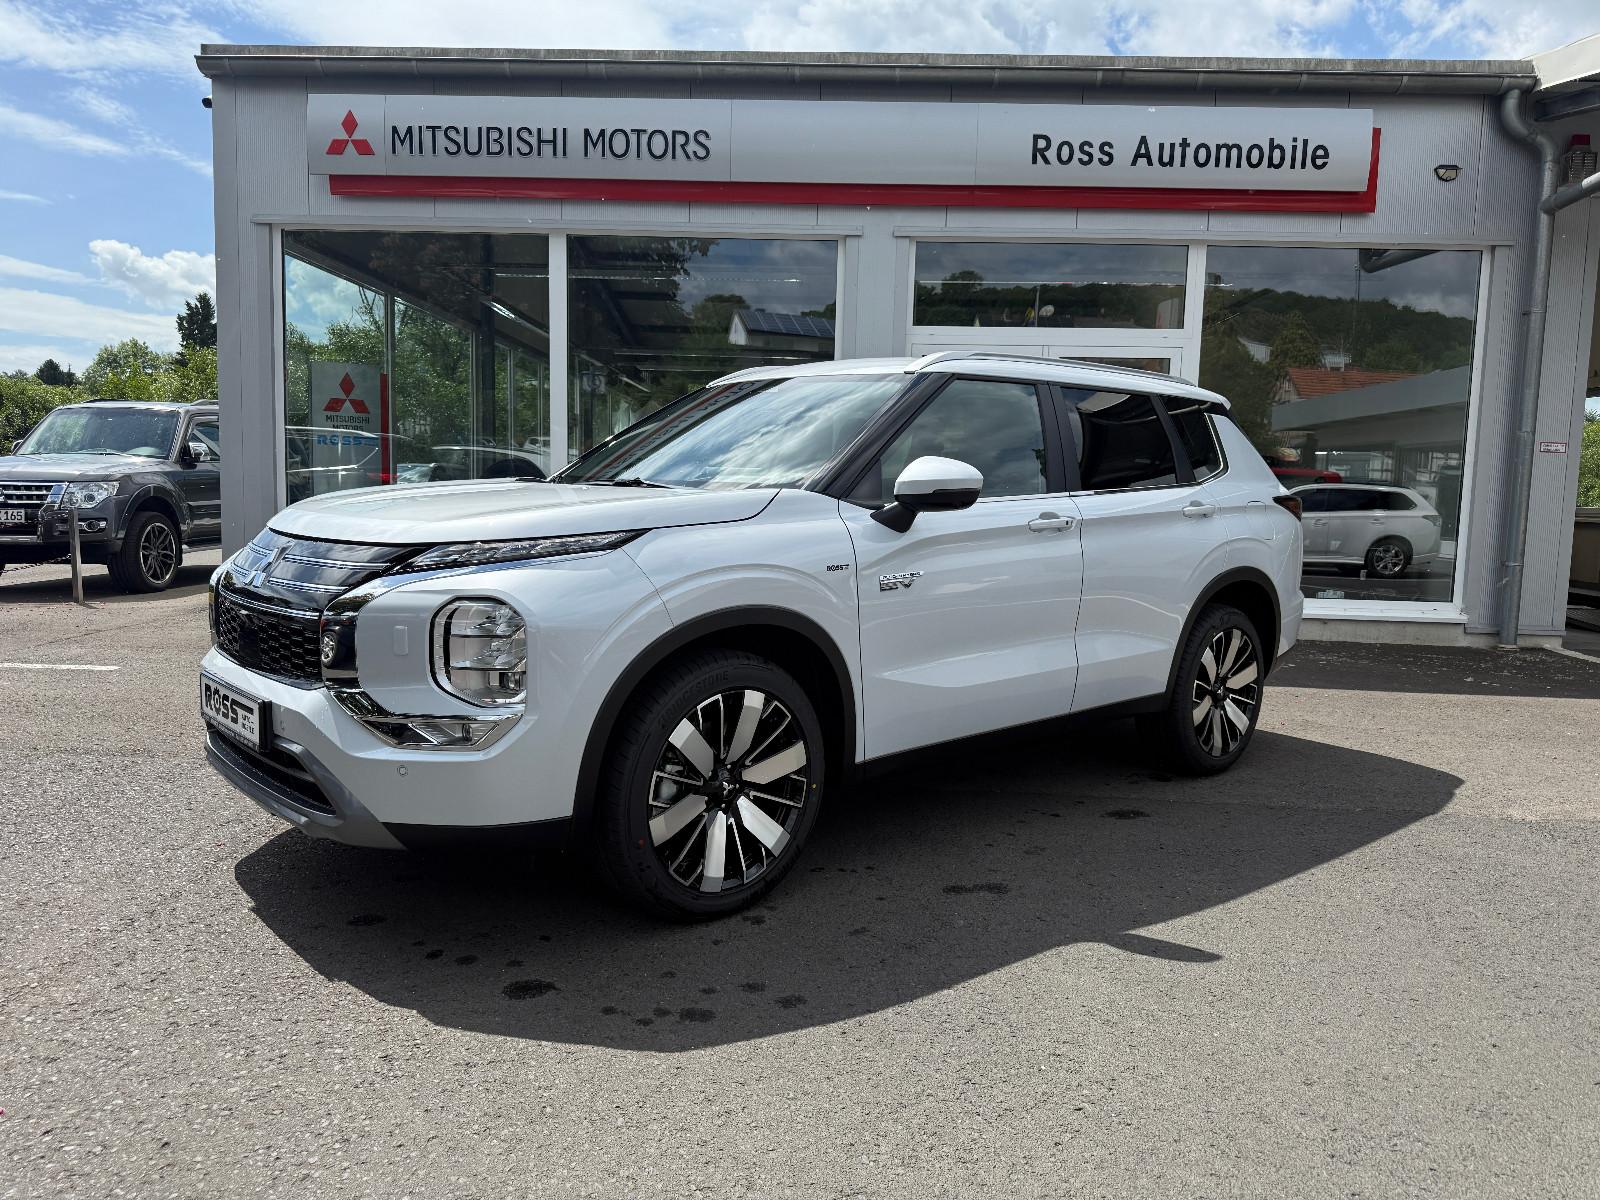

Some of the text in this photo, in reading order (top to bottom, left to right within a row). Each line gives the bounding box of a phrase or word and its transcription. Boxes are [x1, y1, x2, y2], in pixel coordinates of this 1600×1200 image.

[391, 125, 712, 161] MITSUBISHI MOTORS
[1031, 133, 1330, 170] Ross Automobile
[325, 415, 370, 424] MITSUBISHI
[4, 510, 23, 521] 165
[204, 682, 253, 725] ROSS
